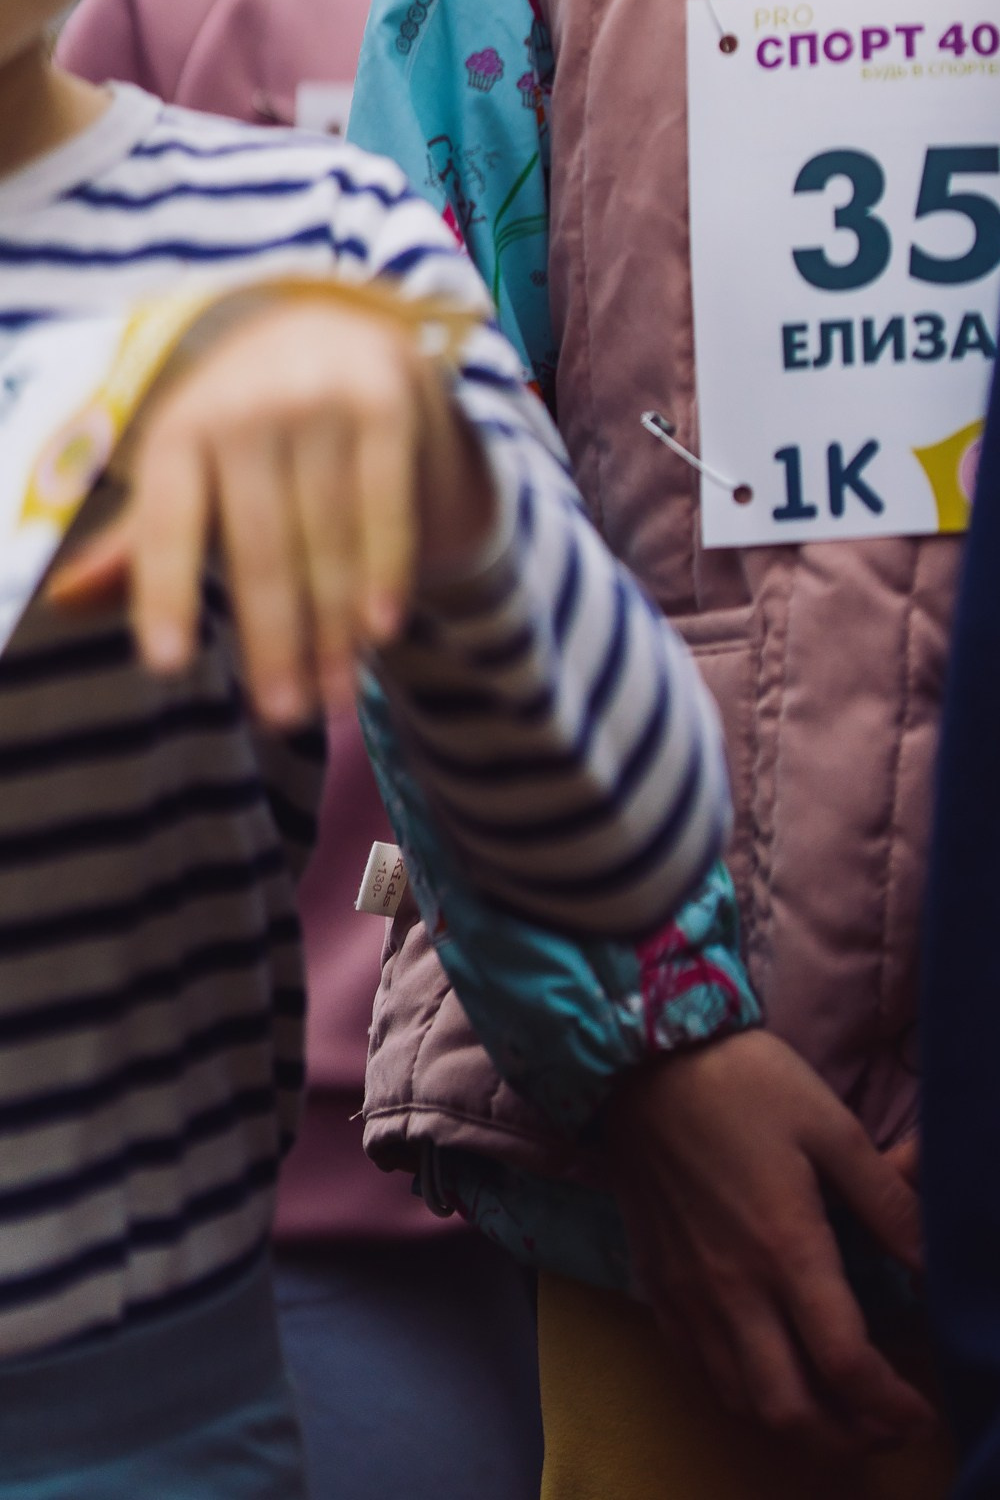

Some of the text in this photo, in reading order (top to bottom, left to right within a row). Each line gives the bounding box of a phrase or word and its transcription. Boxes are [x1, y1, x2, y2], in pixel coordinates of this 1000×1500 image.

[754, 3, 814, 30] PRO
[756, 22, 1000, 70] СПОРТ 40
[781, 312, 997, 372] ЕЛИЗА
